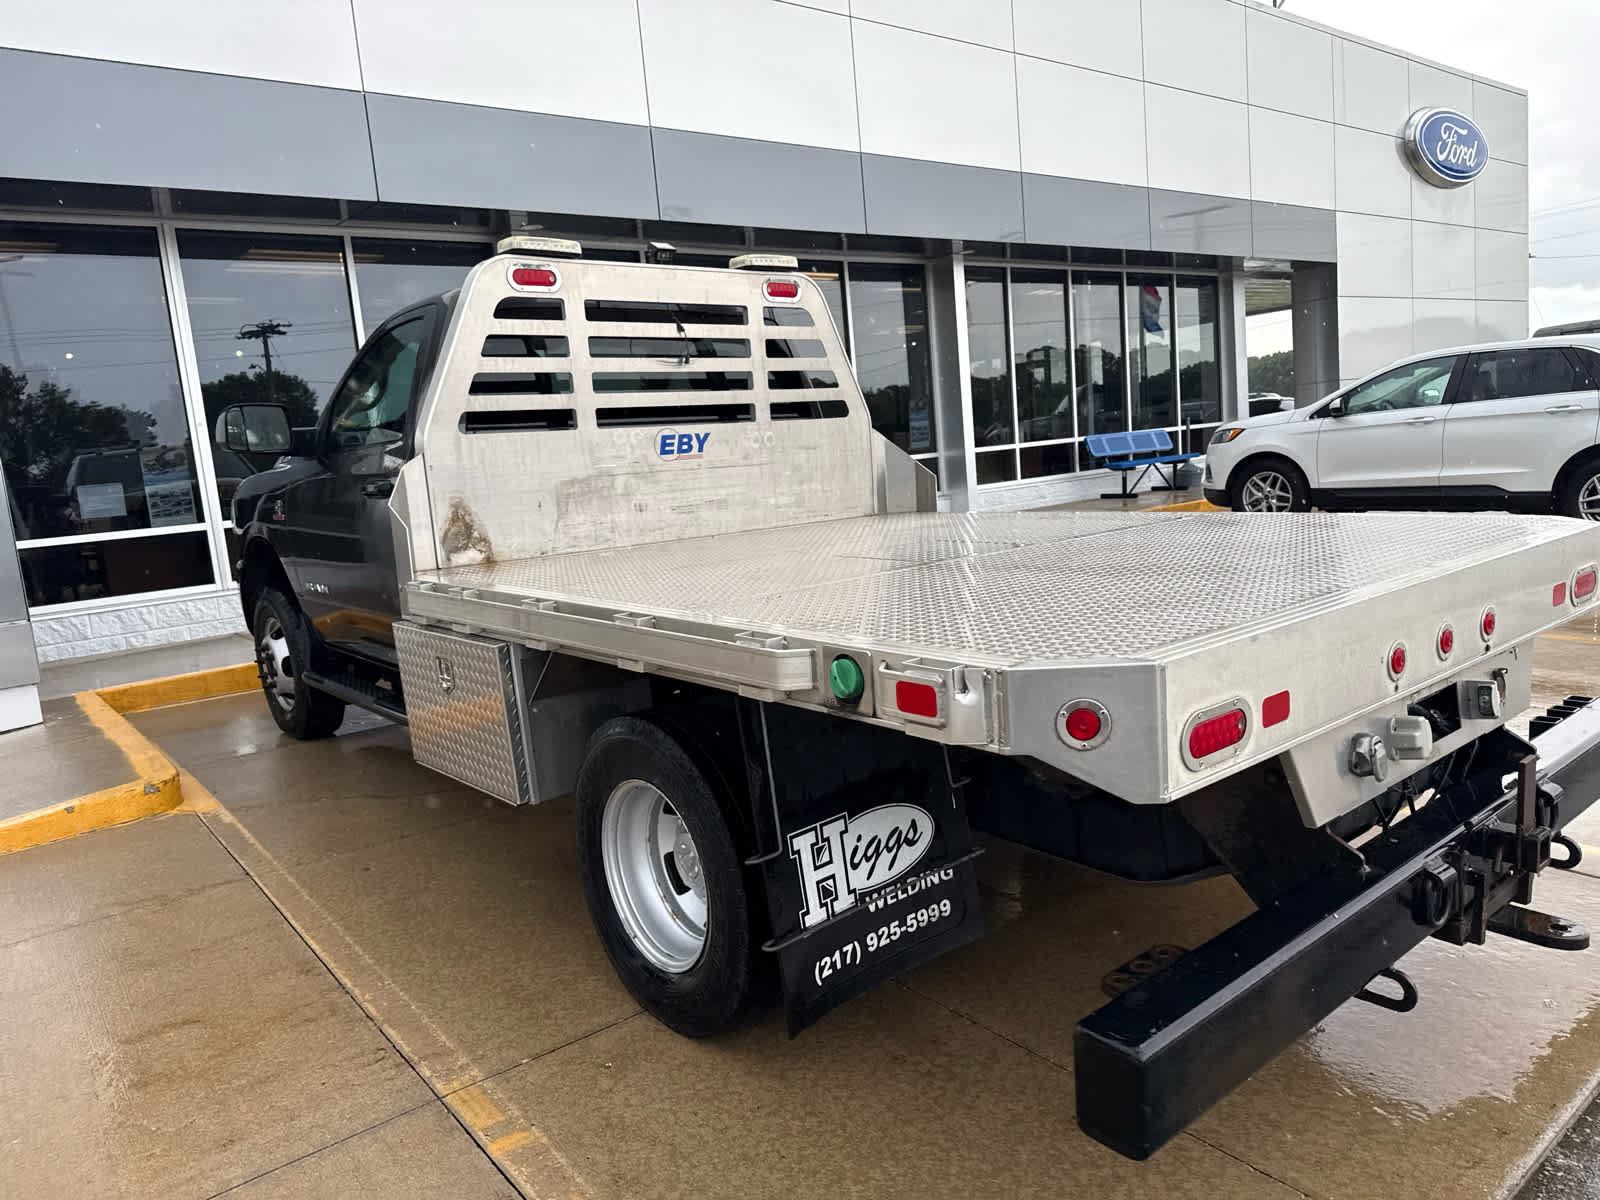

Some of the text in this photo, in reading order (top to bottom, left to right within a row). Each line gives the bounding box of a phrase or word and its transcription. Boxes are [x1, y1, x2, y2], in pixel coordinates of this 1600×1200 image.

[1437, 122, 1478, 167] Ford
[660, 431, 711, 456] EBY
[788, 812, 924, 928] Higgs
[865, 867, 954, 913] WELDING
[814, 899, 952, 986] (217) 925-5999
